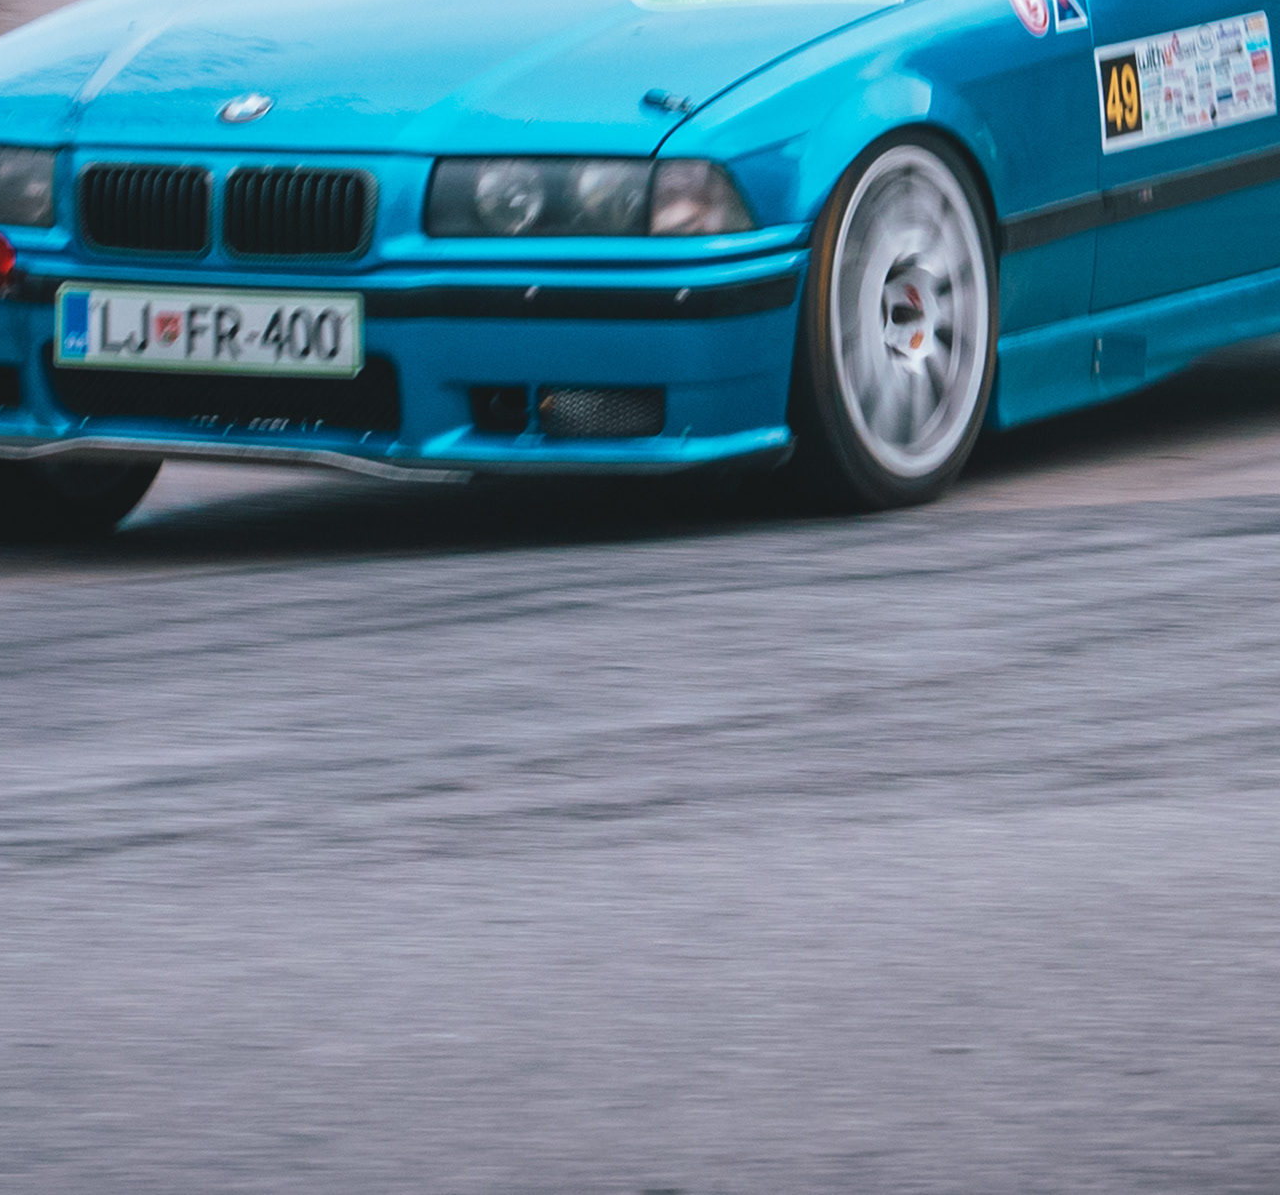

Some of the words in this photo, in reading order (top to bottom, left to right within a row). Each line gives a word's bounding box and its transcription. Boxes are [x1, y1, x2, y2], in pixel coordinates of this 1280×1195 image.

[1107, 63, 1138, 131] 49
[99, 299, 151, 355] LJ
[185, 304, 343, 361] FR-400
